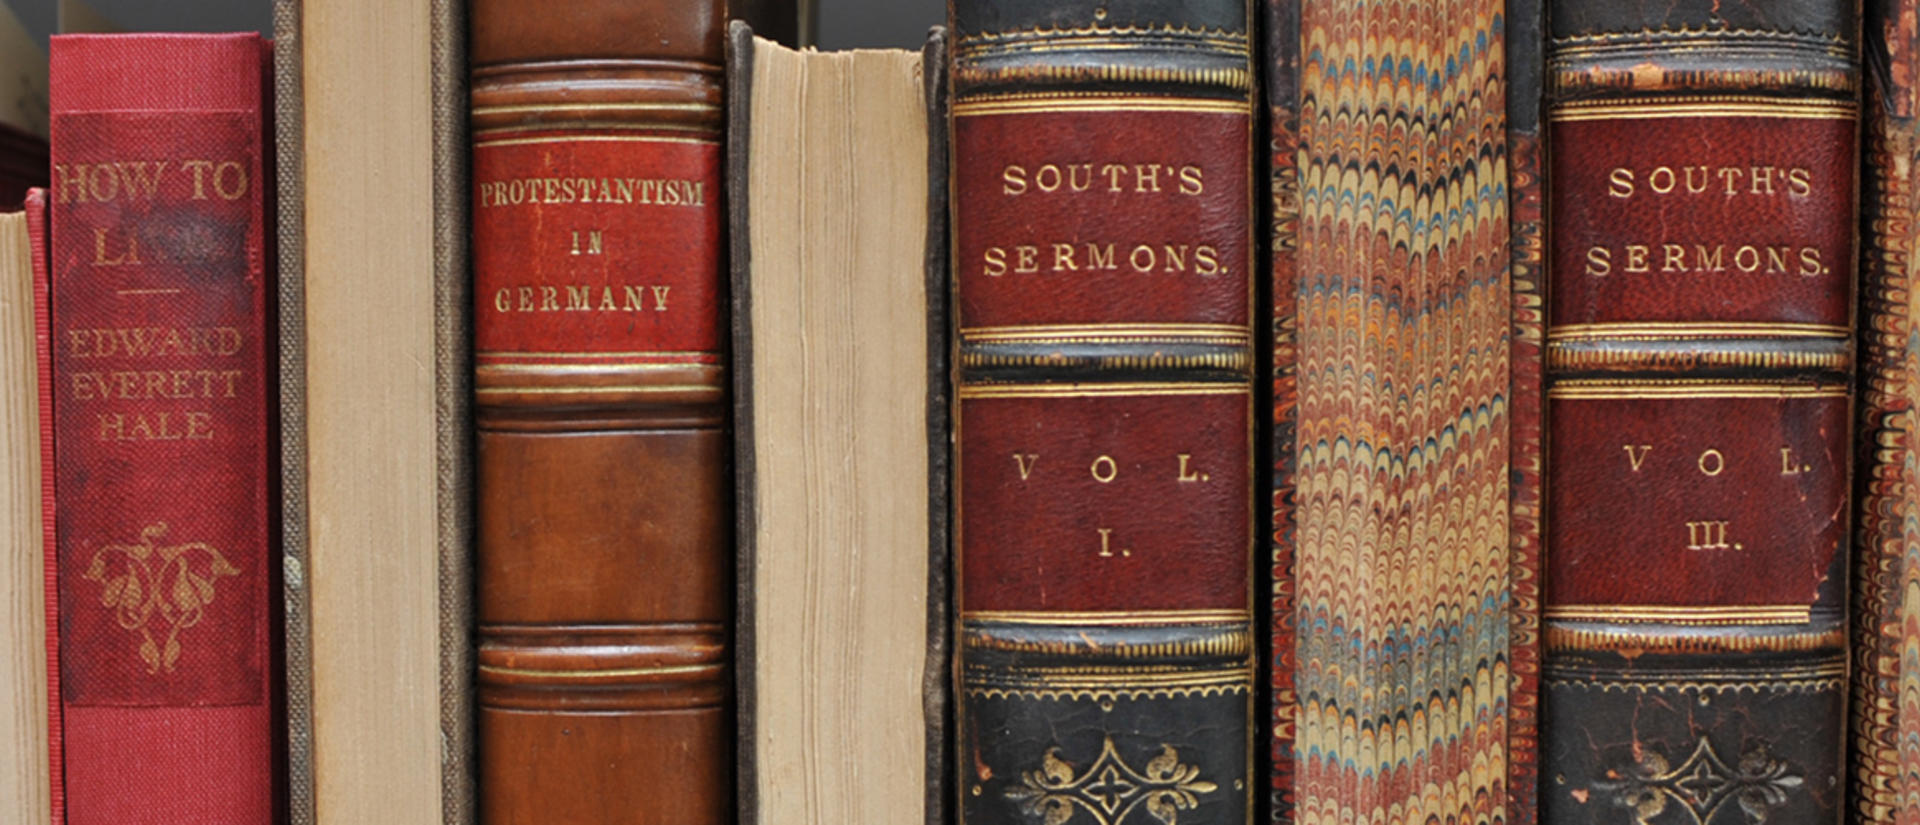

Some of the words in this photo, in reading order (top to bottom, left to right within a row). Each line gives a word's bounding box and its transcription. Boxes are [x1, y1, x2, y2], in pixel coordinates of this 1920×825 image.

[55, 161, 168, 203] HOW
[181, 159, 248, 200] TO
[479, 177, 705, 207] PROTESTANTISM
[1003, 163, 1204, 195] SOUTH'S
[1608, 165, 1812, 198] SOUTH'S
[570, 230, 603, 255] IN
[983, 243, 1229, 277] SERMONS.
[1585, 244, 1830, 277] SERMONS.
[495, 285, 671, 313] GERMANY
[68, 326, 243, 359] EDWARD
[71, 369, 242, 401] EVERETT
[97, 410, 215, 441] HALE
[1097, 528, 1131, 557] I.
[1685, 520, 1743, 551] III.
